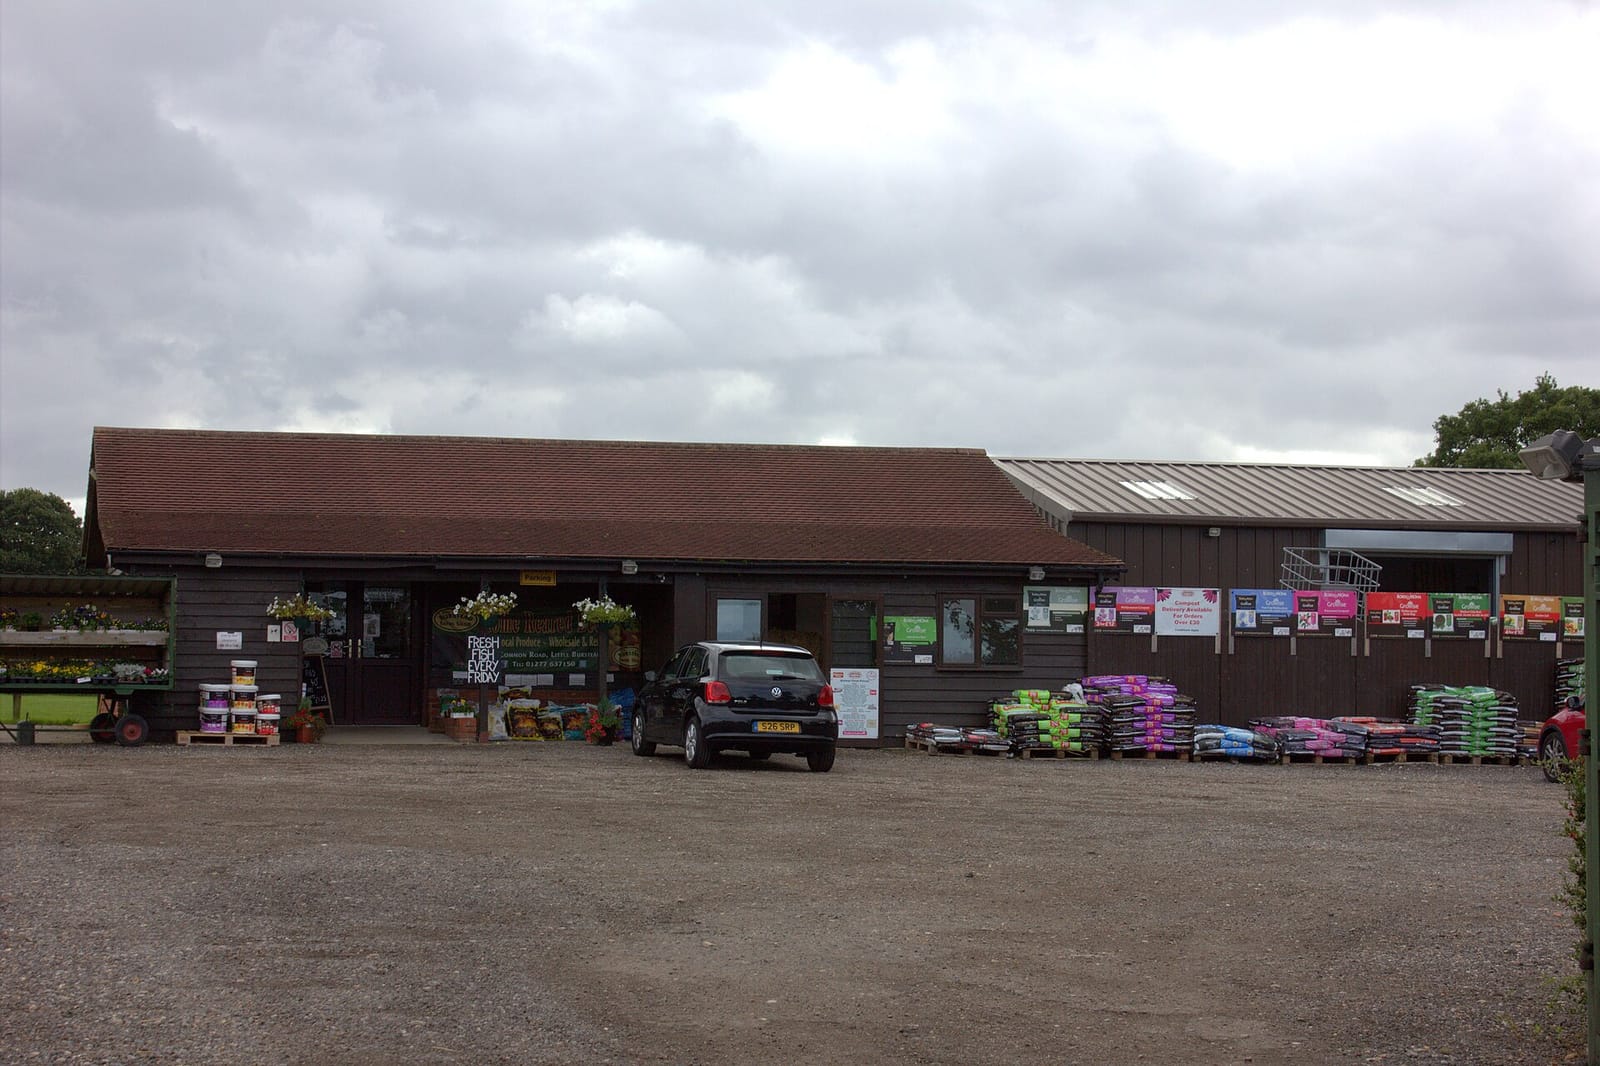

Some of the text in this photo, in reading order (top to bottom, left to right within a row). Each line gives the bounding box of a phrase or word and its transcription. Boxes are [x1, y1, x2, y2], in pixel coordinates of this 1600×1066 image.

[522, 611, 573, 634] Reared
[467, 635, 500, 649] FRESH
[515, 635, 541, 647] Produce
[548, 635, 580, 647] Wholesale
[471, 648, 495, 660] FISH
[467, 660, 499, 672] EVERY
[525, 660, 548, 668] 01277
[467, 671, 500, 684] FRIDAY
[761, 721, 796, 731] S26 SRP
